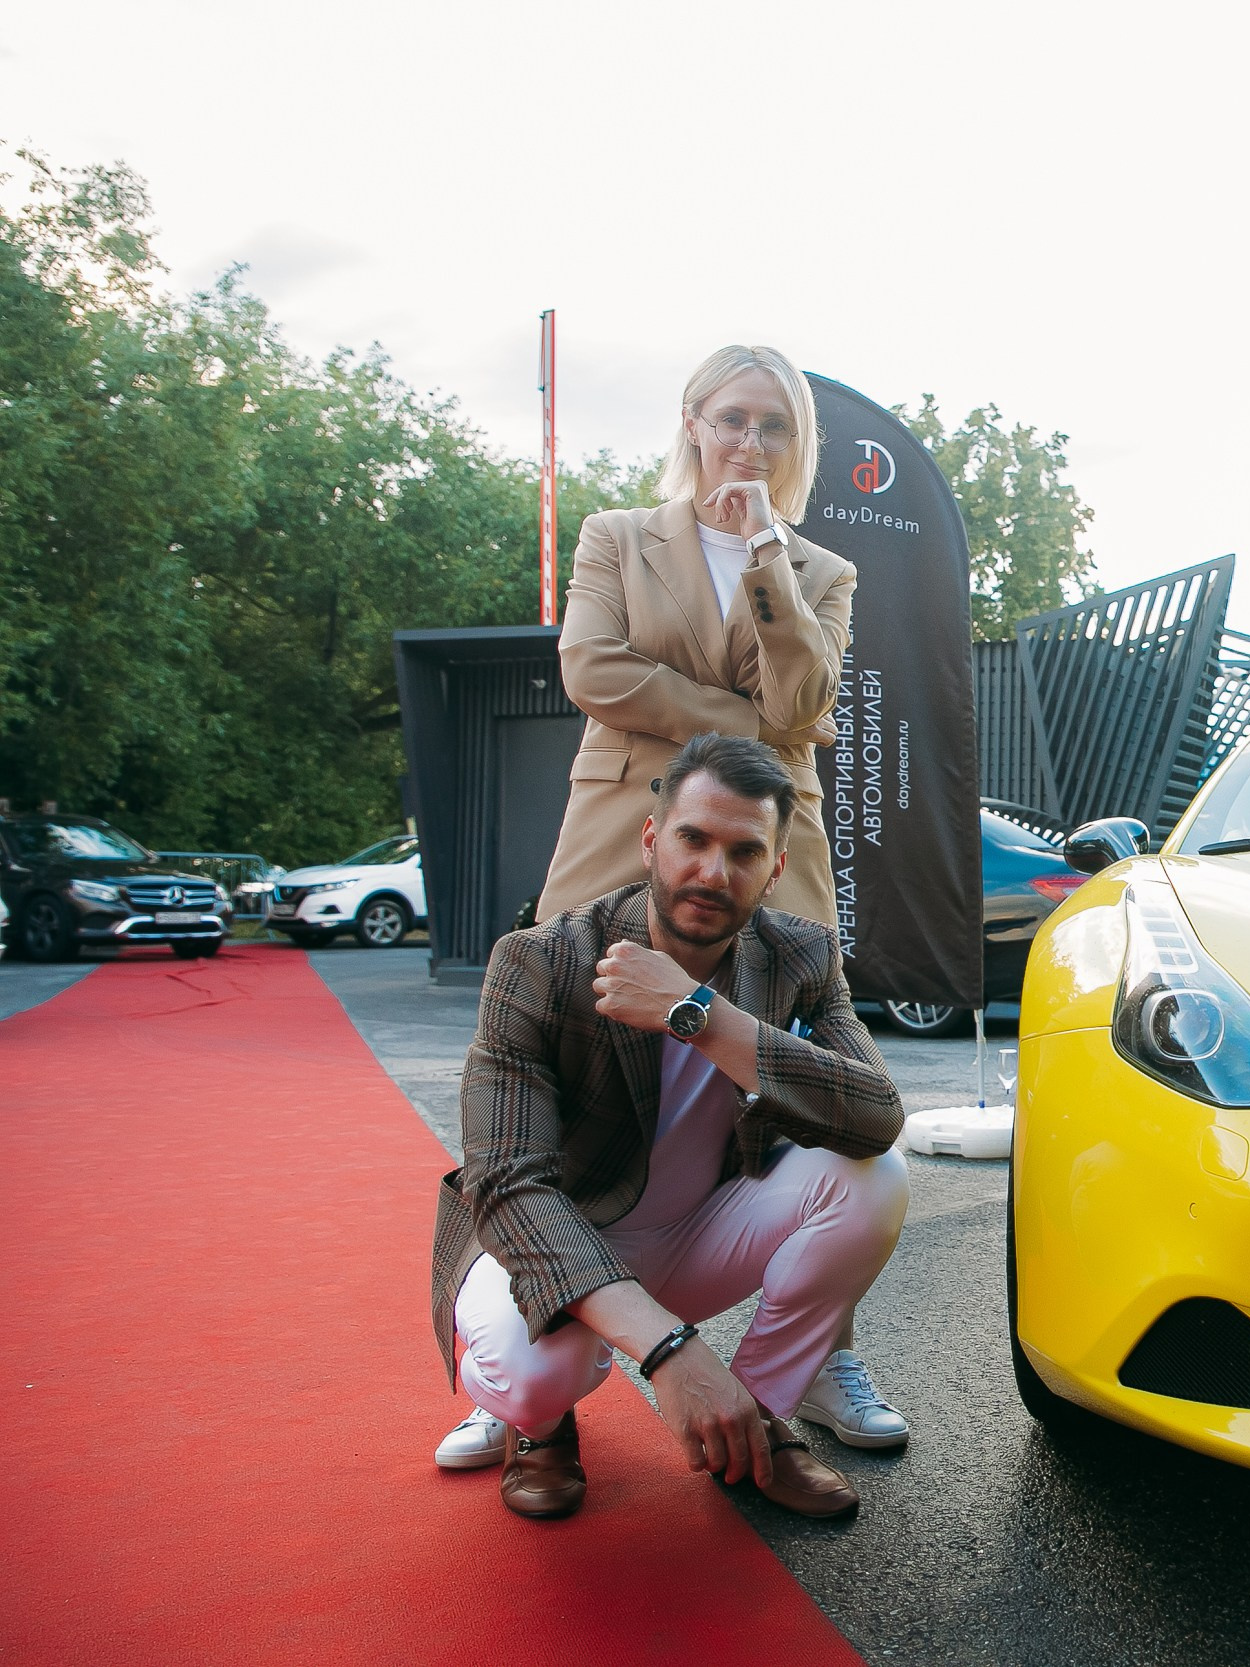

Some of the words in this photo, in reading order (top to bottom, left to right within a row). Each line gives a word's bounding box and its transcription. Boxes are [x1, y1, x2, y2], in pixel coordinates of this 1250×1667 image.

[823, 502, 920, 534] dayDream
[835, 703, 855, 859] СПОРТИВНЫХ
[859, 669, 882, 847] АВТОМОБИЛЕЙ
[896, 719, 911, 809] daydream.ru
[836, 866, 857, 959] АРЕНДА
